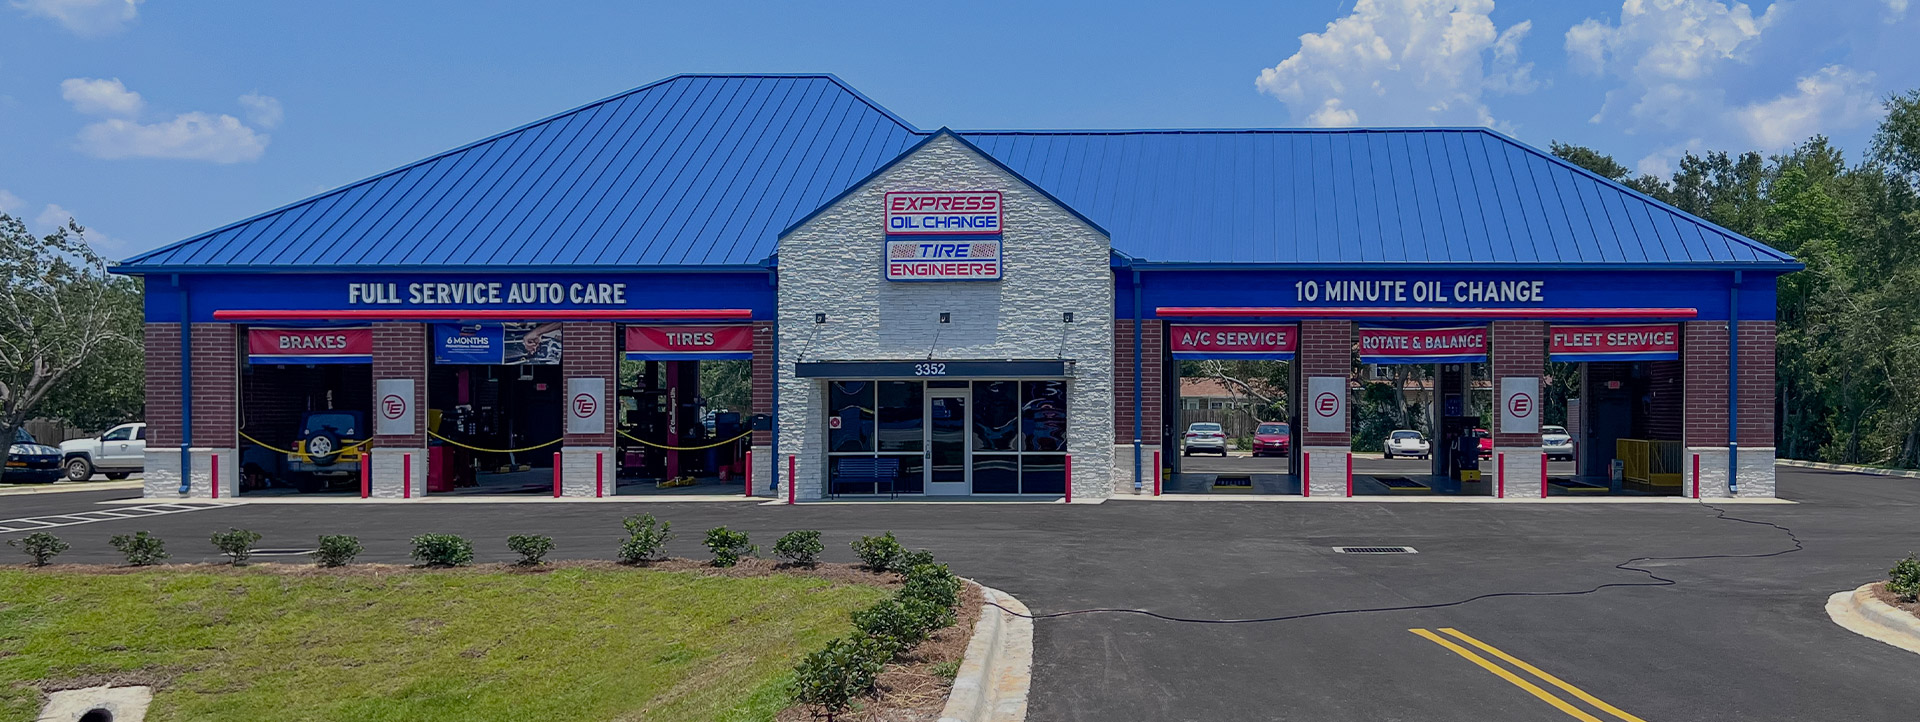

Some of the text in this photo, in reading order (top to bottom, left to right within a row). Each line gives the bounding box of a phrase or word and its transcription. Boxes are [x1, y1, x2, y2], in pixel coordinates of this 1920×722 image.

[891, 197, 997, 211] EXPRESS
[891, 216, 997, 229] OIL CHANGE
[920, 244, 970, 258] TIRE
[890, 263, 997, 276] ENGINEERS
[349, 283, 627, 304] FULL SERVICE AUTO CARE
[1295, 281, 1544, 302] 10 MINUTE OIL CHANGE
[279, 335, 347, 349] BRAKES
[447, 337, 489, 345] 6 MONTHS
[666, 332, 715, 346] TIRES
[1181, 331, 1287, 347] A/C SERVICE
[1362, 334, 1483, 349] ROTATE & BALANCE
[1553, 332, 1674, 347] FLEET SERVICE
[915, 363, 946, 376] 3352
[384, 400, 402, 414] TE
[576, 399, 594, 413] TE
[1320, 398, 1335, 411] E
[1513, 398, 1528, 411] E
